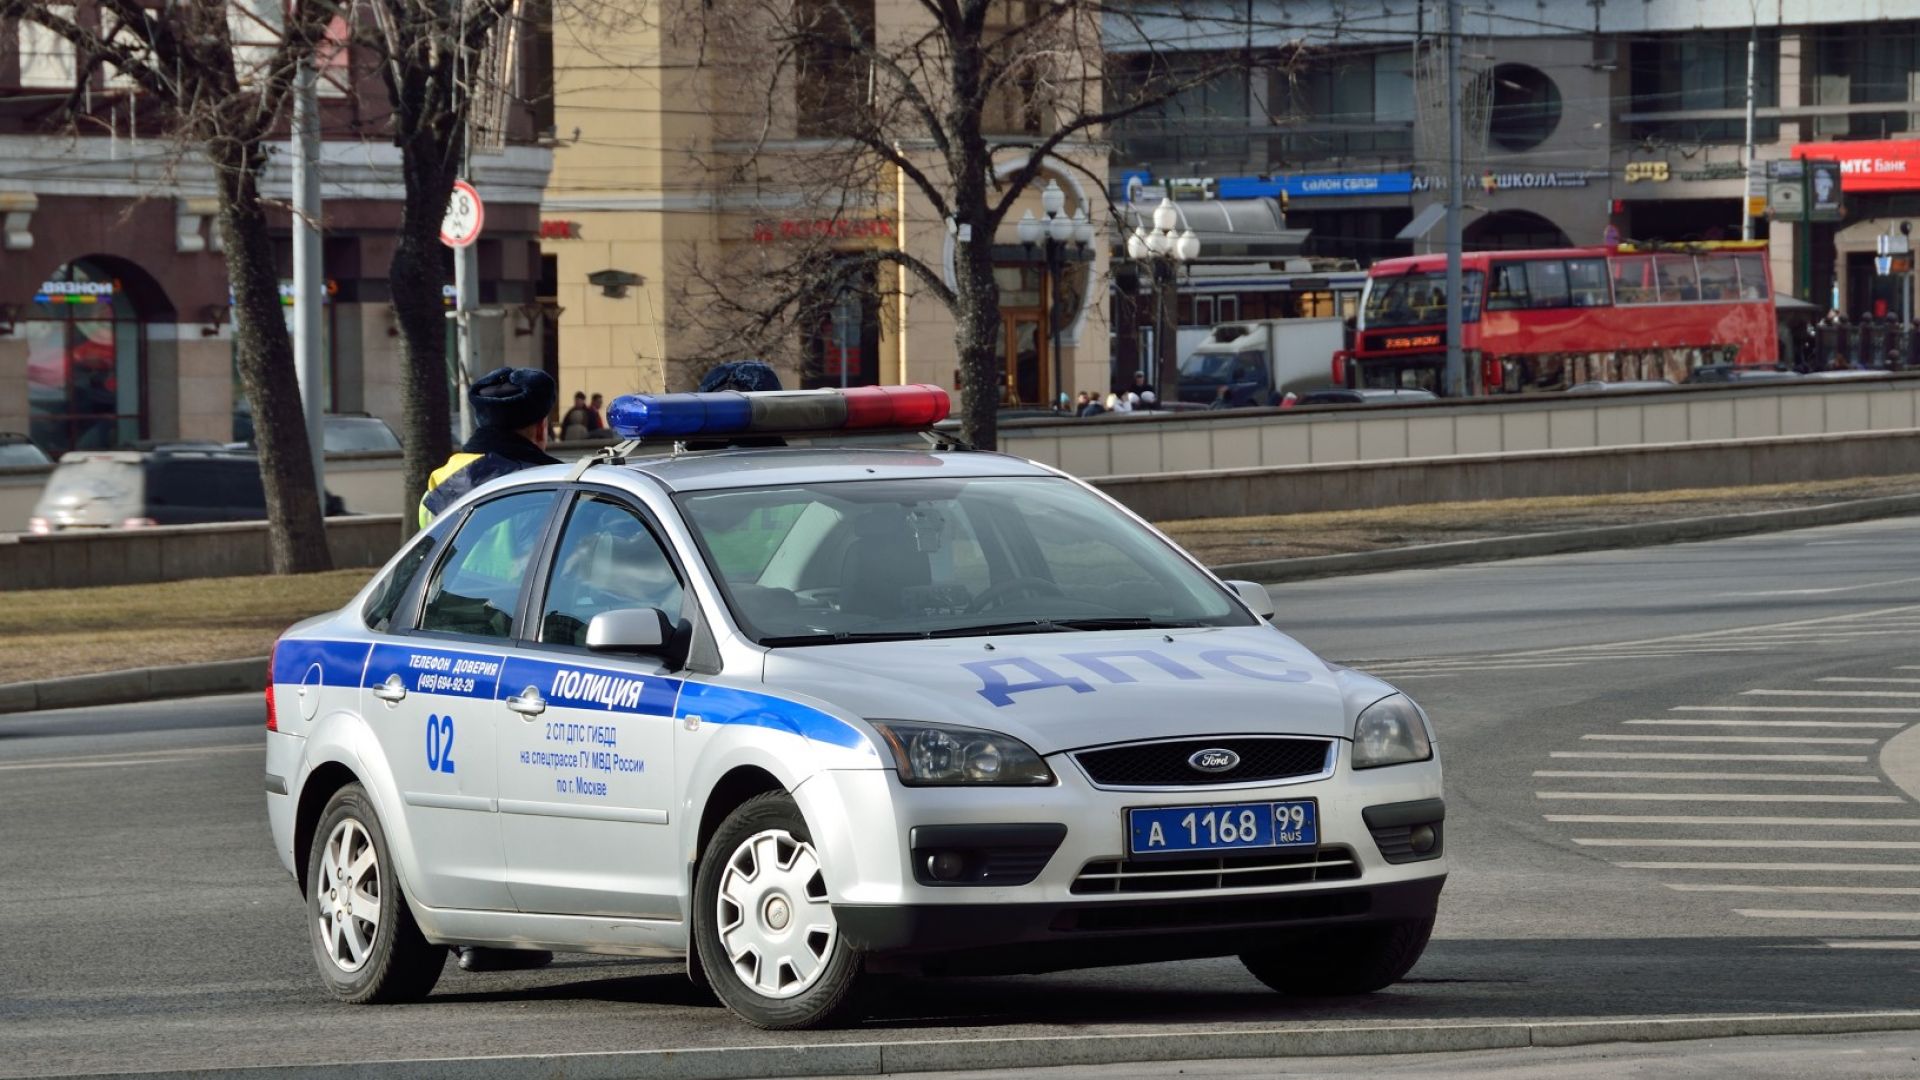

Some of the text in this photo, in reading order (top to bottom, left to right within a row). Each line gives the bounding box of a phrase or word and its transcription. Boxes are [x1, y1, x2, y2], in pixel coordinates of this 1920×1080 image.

[1840, 157, 1907, 174] МТС Банк
[1497, 171, 1557, 188] ШКОЛА
[409, 654, 499, 676] ТЕЛЕФОН ДОВЕРИЯ
[417, 672, 475, 693] (495) 694-92-29
[551, 669, 645, 710] ПОЛИЦИЯ
[959, 650, 1313, 707] ДПС
[427, 713, 455, 774] 02
[546, 722, 616, 748] 2 СП ДПС ГИБДД
[519, 750, 645, 774] на спецтрассе ГУ МВД России
[1201, 753, 1229, 767] Ford
[556, 776, 607, 796] по г. Москве
[1181, 809, 1257, 845] 1168
[1275, 805, 1305, 831] 99
[1280, 831, 1302, 842] RUS
